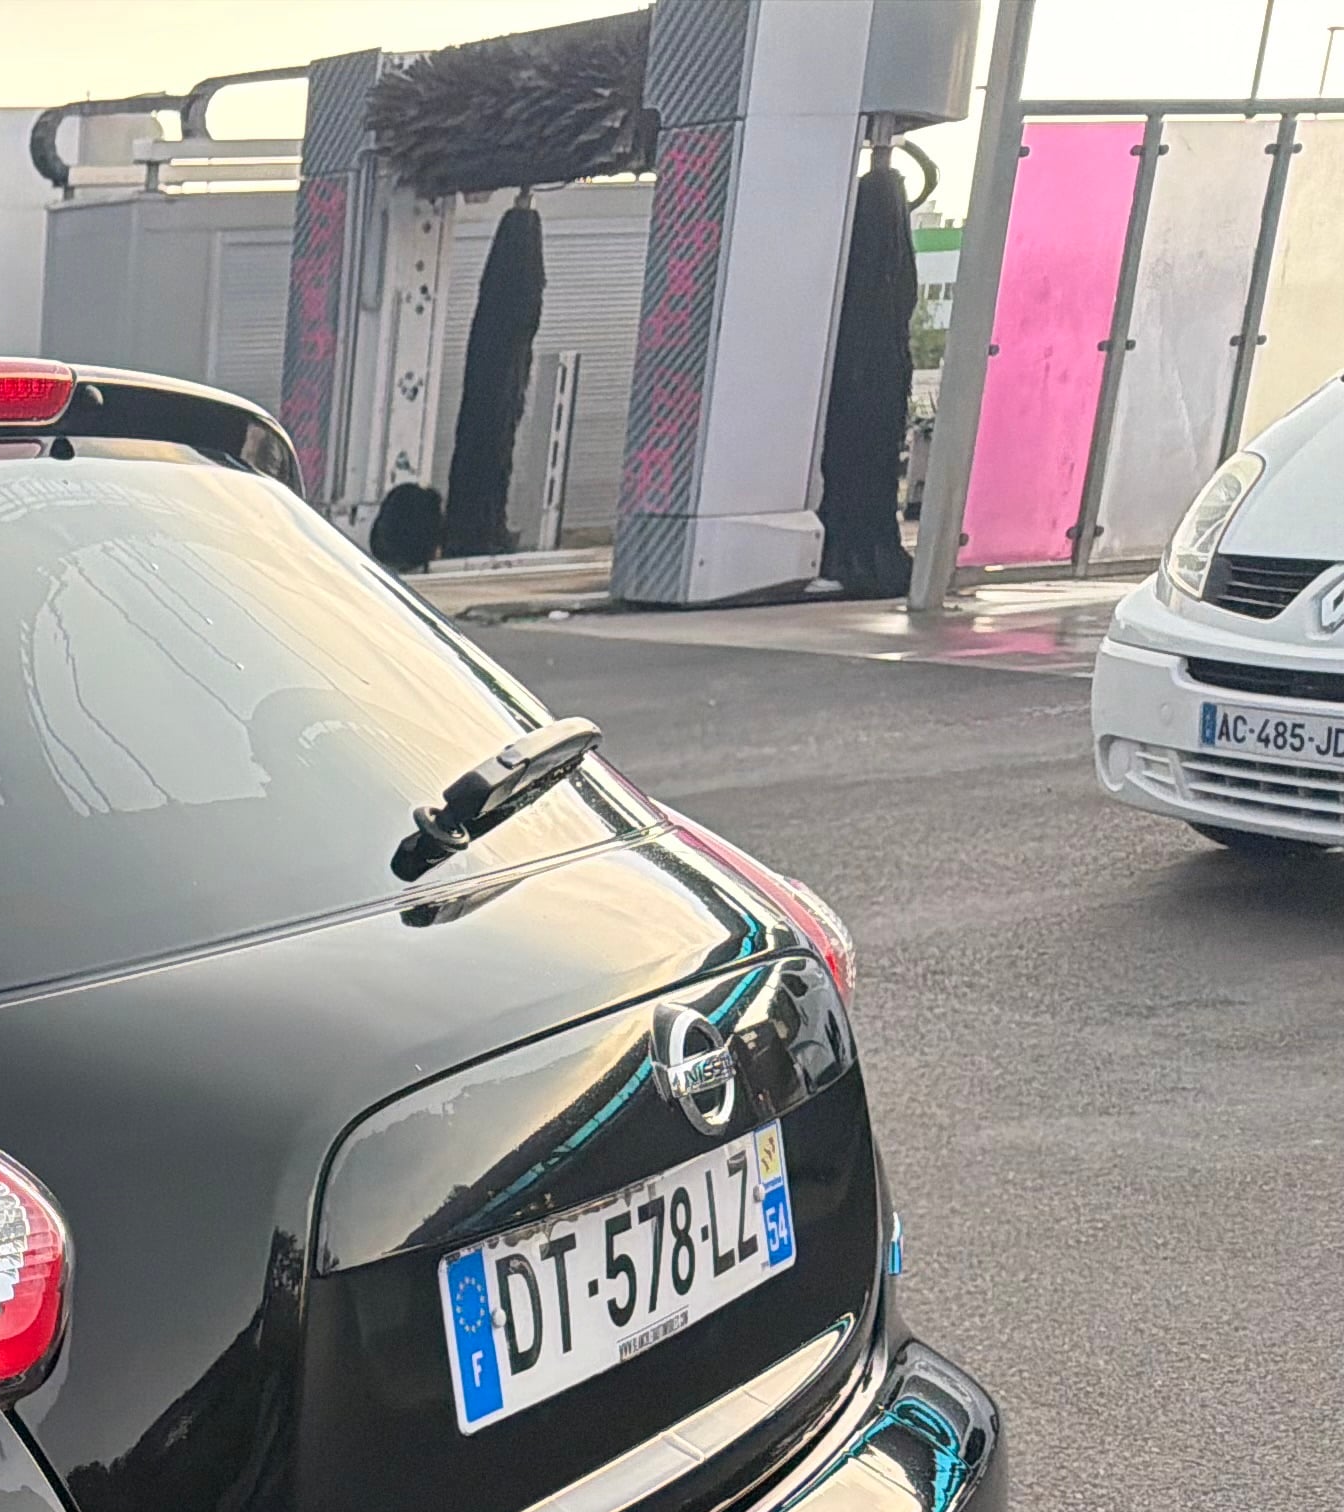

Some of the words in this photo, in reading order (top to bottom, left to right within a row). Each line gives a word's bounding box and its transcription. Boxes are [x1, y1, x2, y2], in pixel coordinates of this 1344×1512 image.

[765, 1201, 789, 1252] 54
[495, 1149, 759, 1377] DT-578-LZ
[471, 1350, 484, 1388] F
